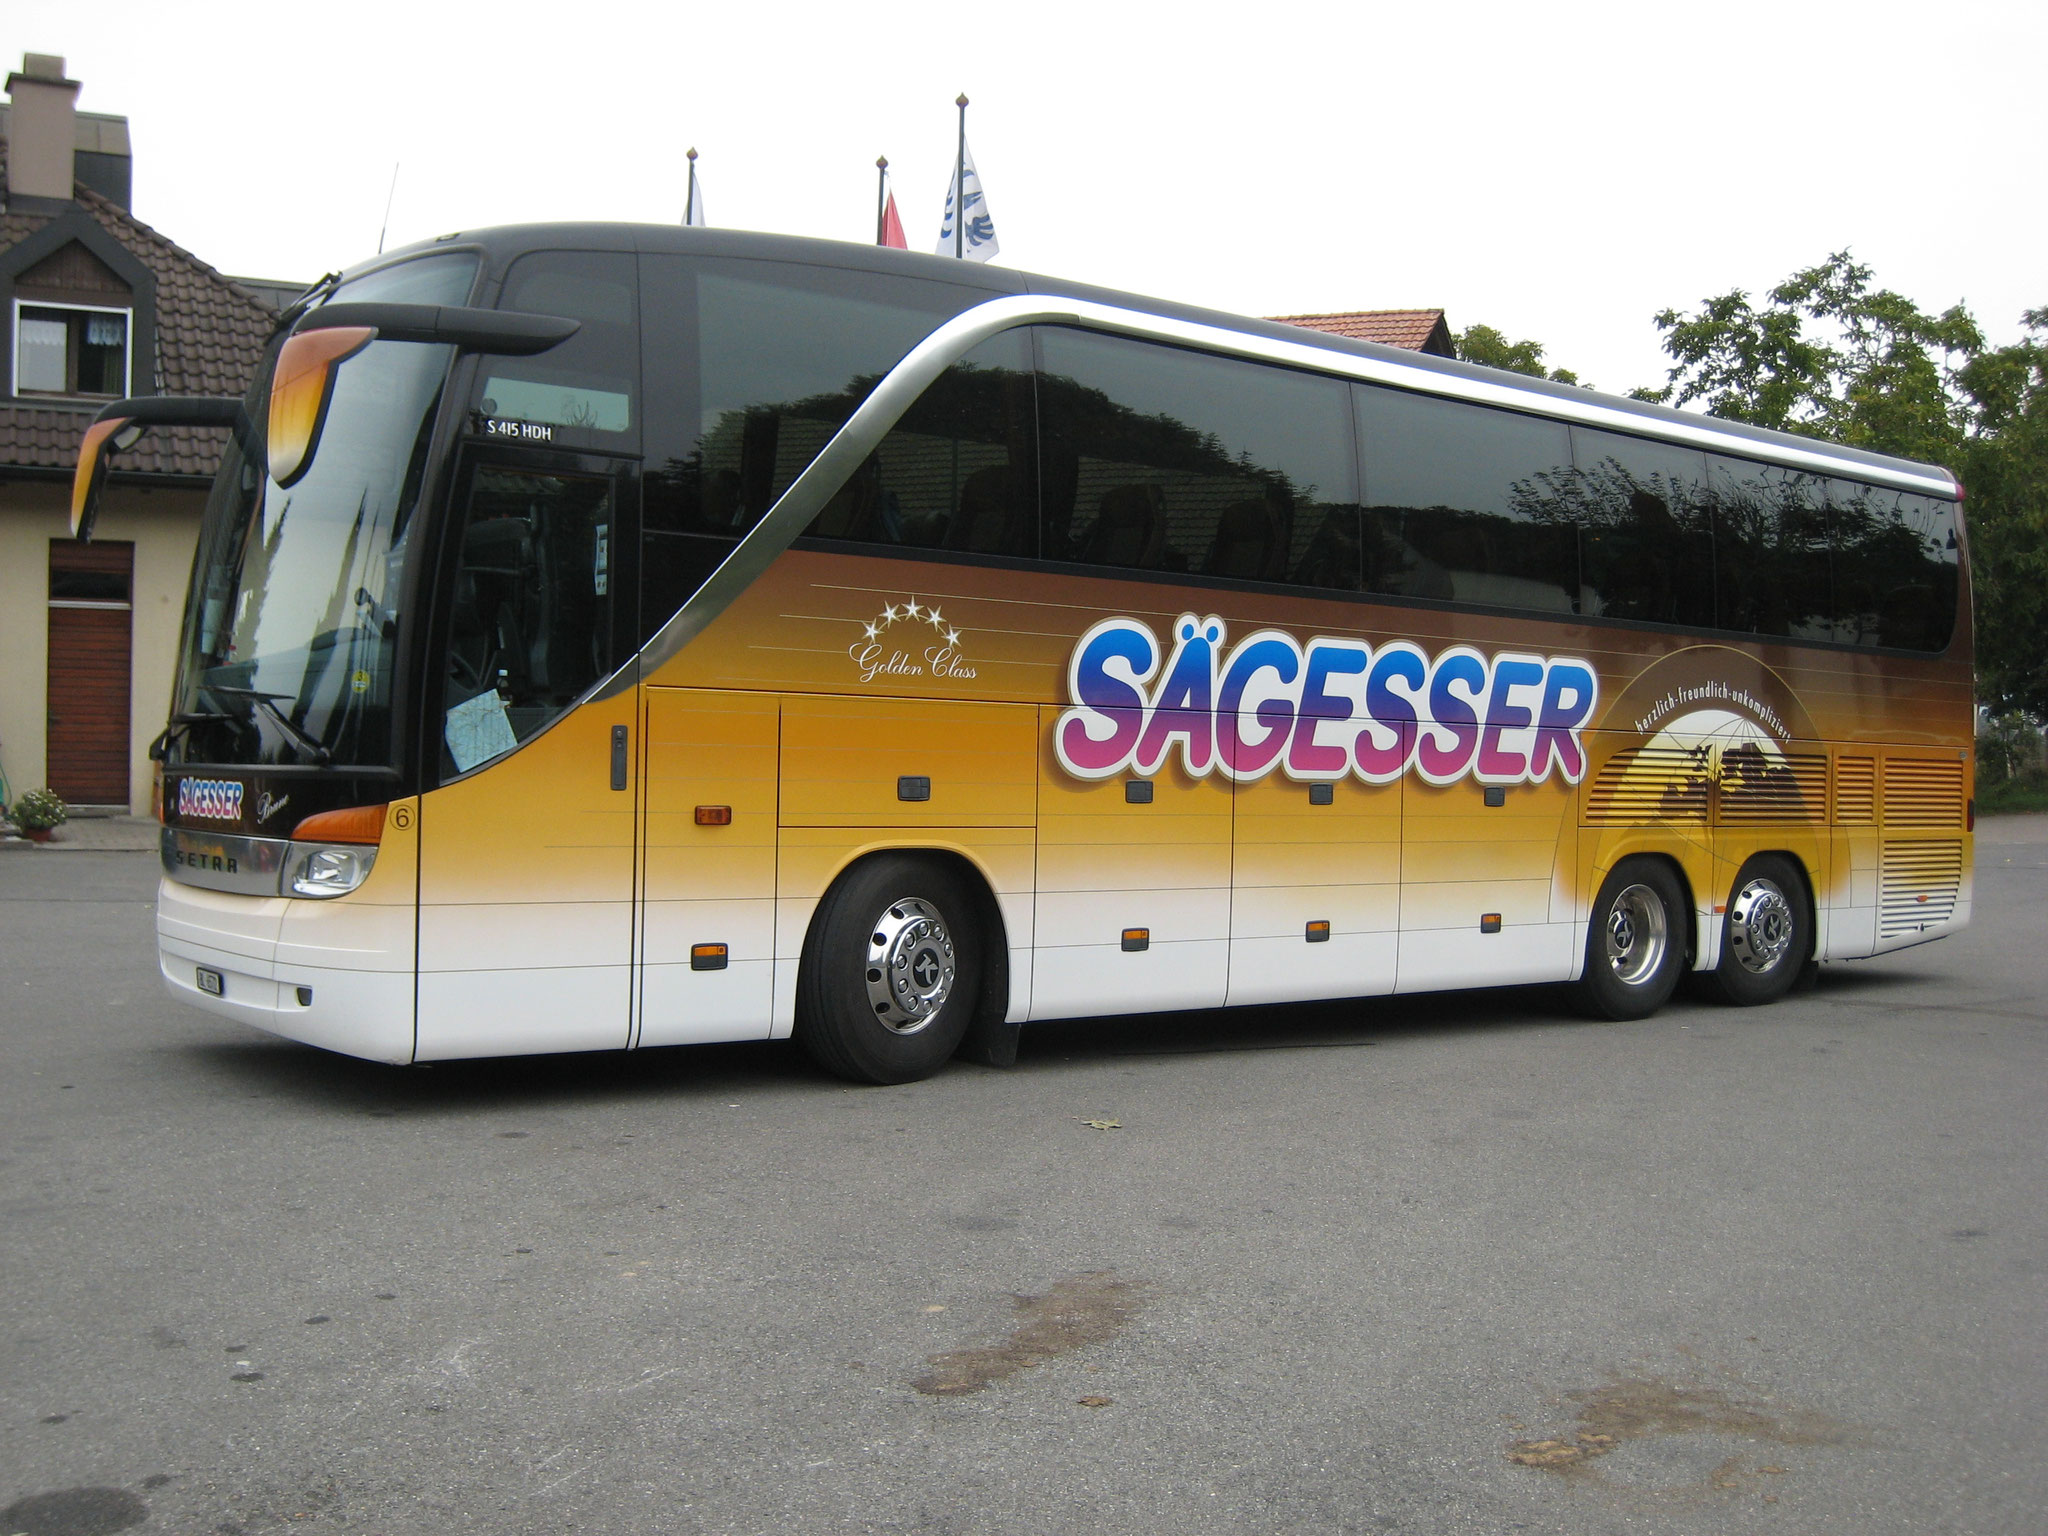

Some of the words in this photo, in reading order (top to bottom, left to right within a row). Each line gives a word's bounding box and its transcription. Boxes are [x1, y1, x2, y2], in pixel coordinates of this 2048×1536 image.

[487, 419, 496, 434] S
[498, 421, 519, 437] 415
[522, 423, 552, 441] HDH
[849, 642, 924, 683] Golden
[924, 646, 977, 679] Class
[1053, 611, 1598, 785] SÄGESSER
[395, 808, 409, 828] 6
[176, 850, 238, 874] SETRA
